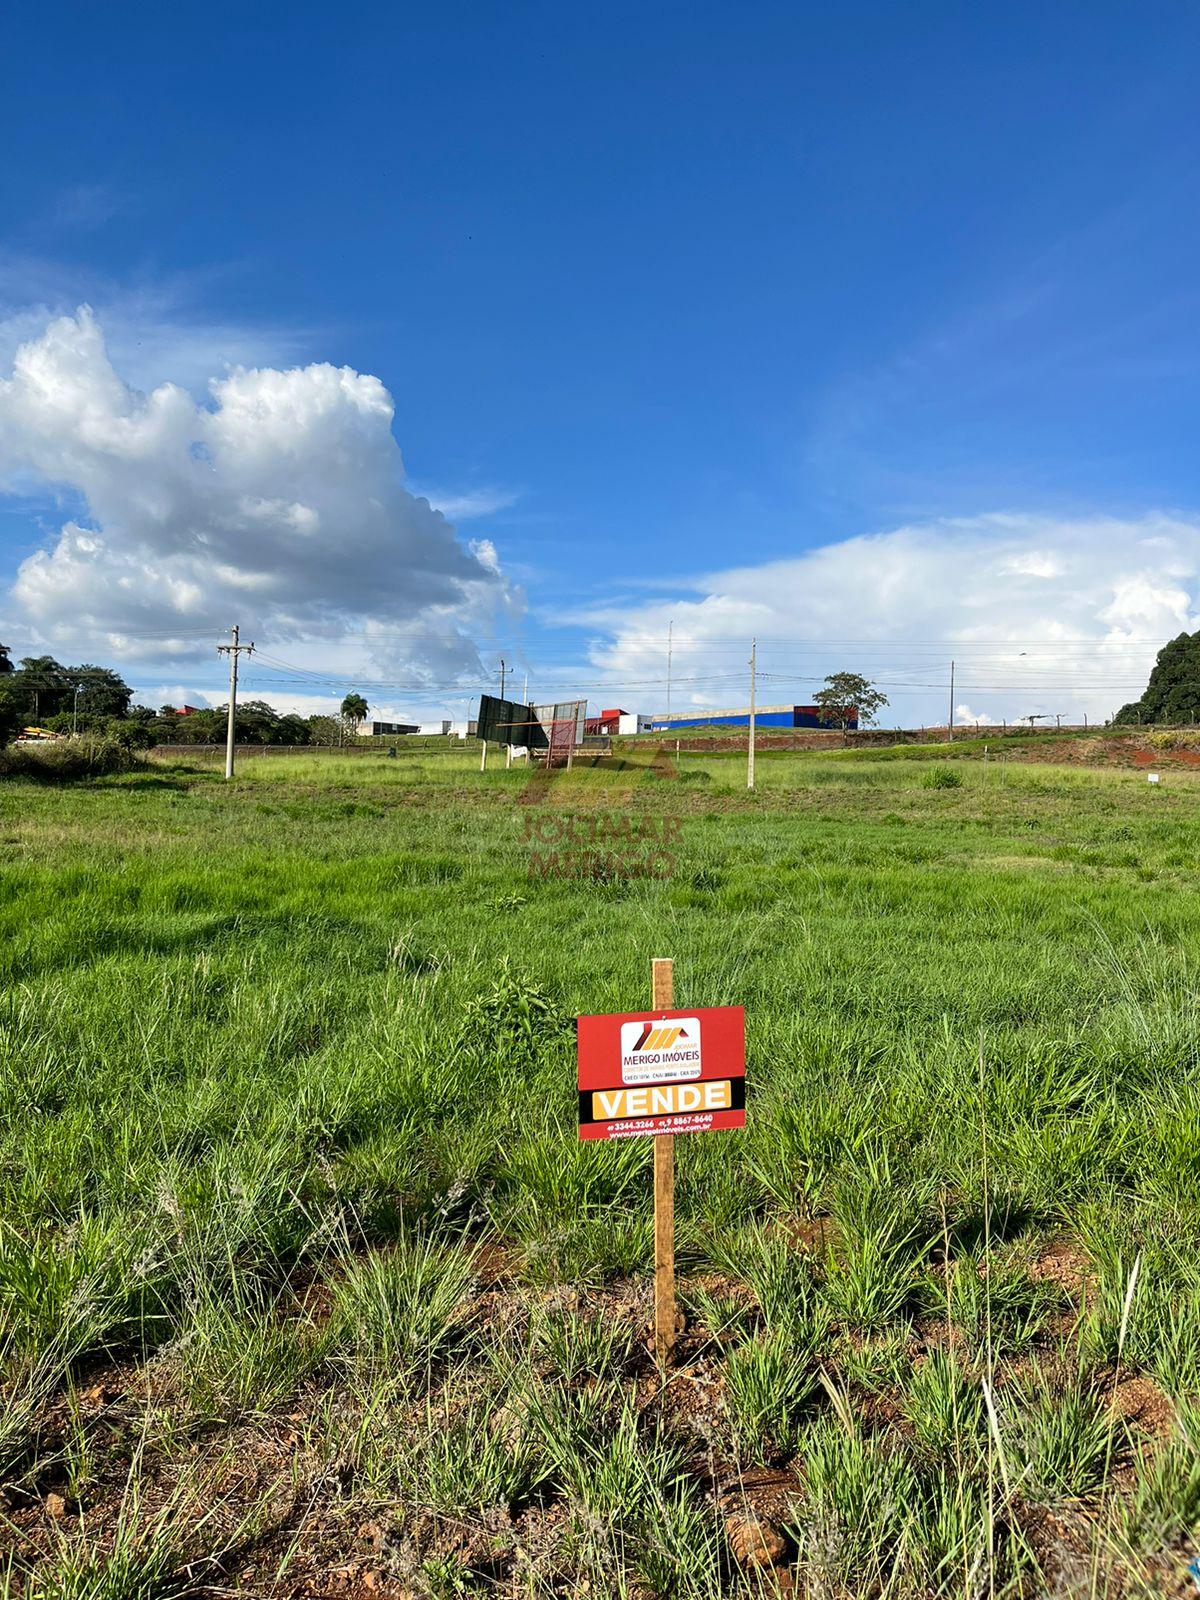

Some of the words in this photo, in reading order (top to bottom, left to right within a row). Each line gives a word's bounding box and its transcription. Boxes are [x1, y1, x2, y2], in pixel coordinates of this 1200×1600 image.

[623, 1053, 661, 1066] MERIGO
[662, 1050, 700, 1063] IMÓVEIS
[598, 1083, 727, 1118] VENDE
[614, 1120, 654, 1131] 3344.3266
[673, 1114, 713, 1126] 8867-8640
